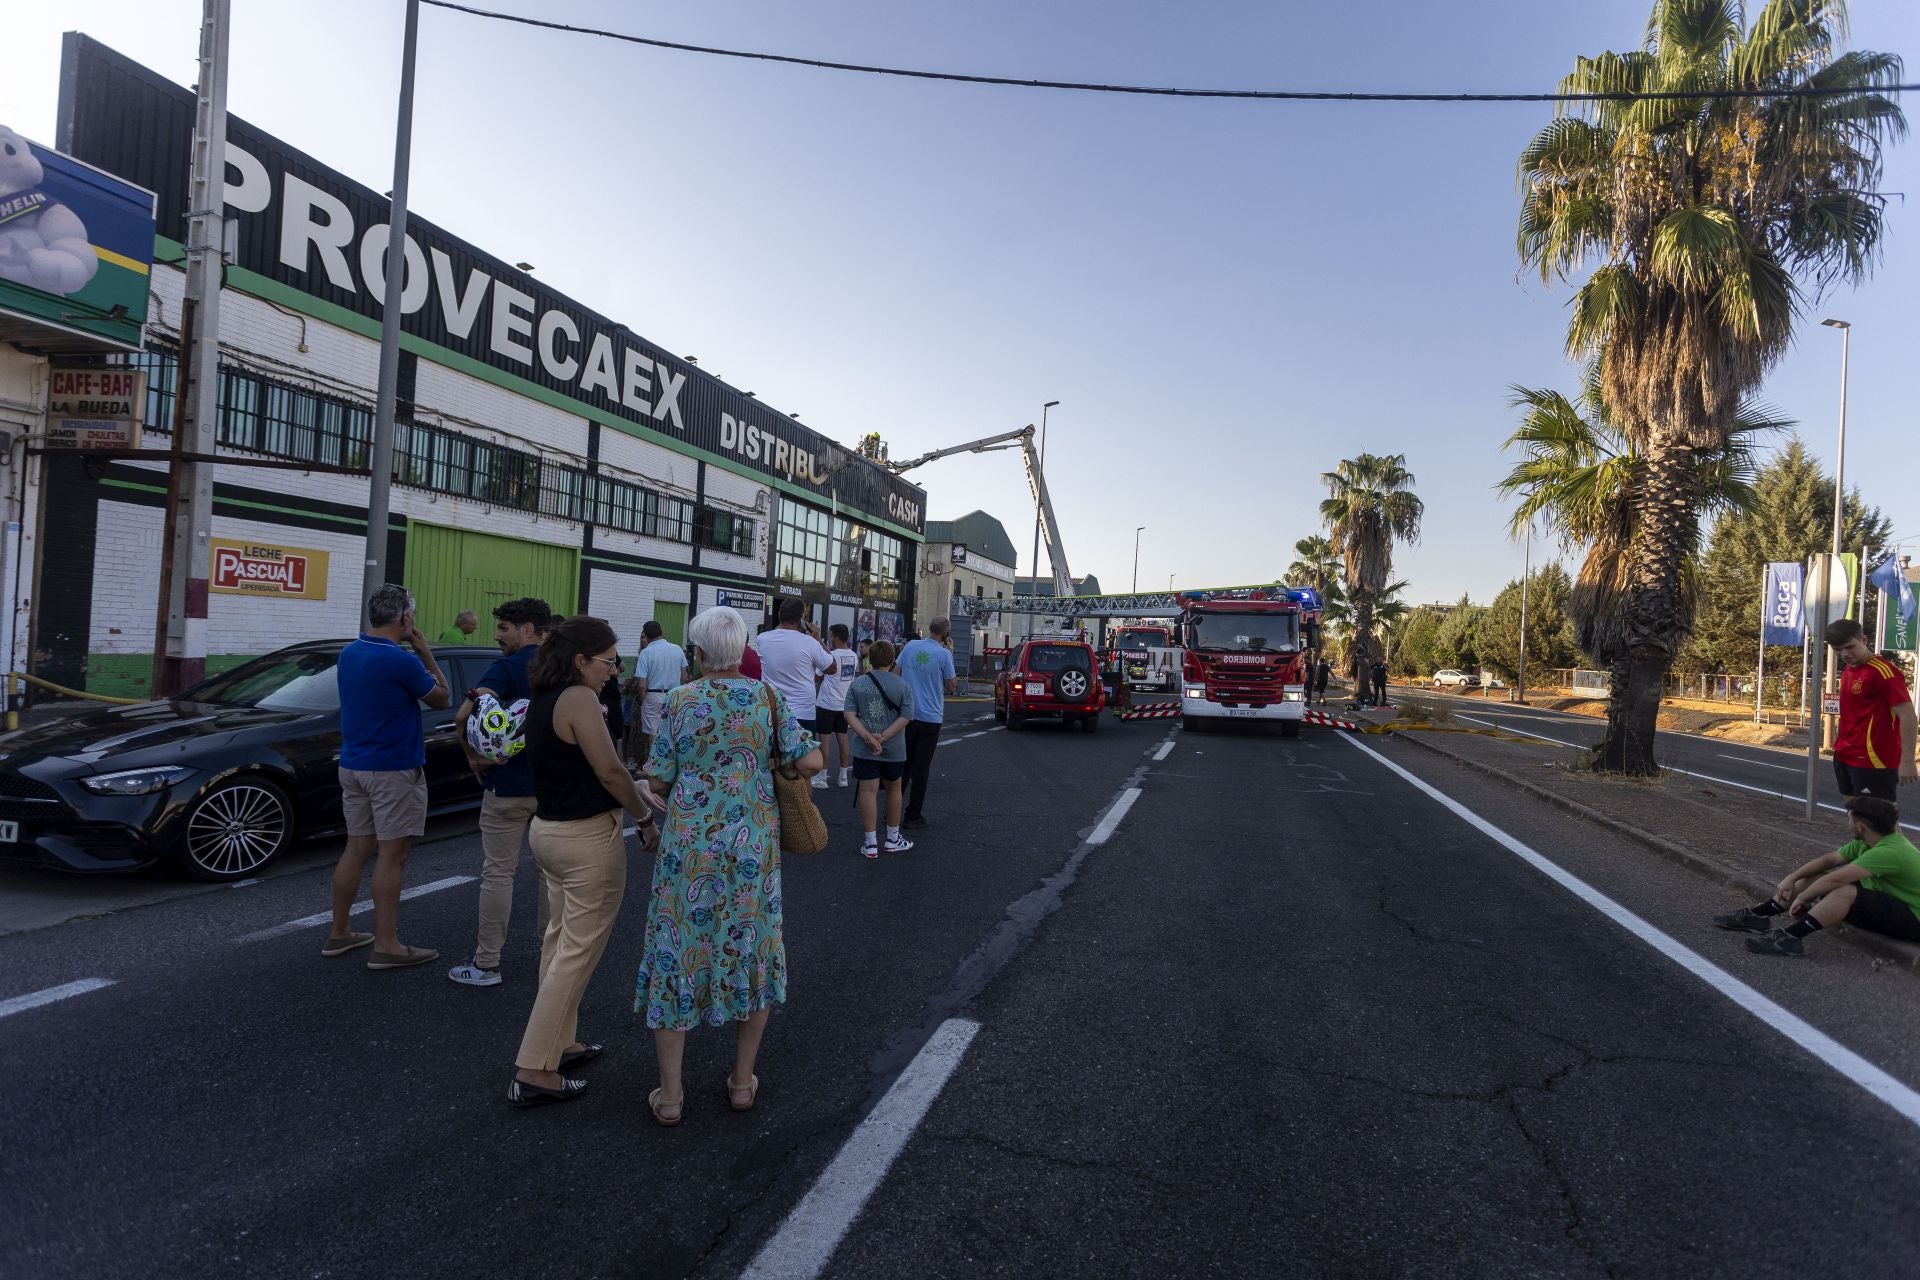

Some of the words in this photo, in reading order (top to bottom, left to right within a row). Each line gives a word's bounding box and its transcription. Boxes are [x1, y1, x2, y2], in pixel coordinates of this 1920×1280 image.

[53, 372, 133, 396] CAFE-BAR
[51, 401, 69, 413] LA
[78, 400, 130, 415] RUEDA
[87, 430, 126, 440] CHULETAS
[888, 493, 919, 527] CASH
[244, 546, 282, 560] LECHE
[218, 553, 301, 589] PASCUAL
[726, 591, 744, 600] PARKING
[779, 584, 802, 597] ENTRADA
[1773, 581, 1791, 628] Roca
